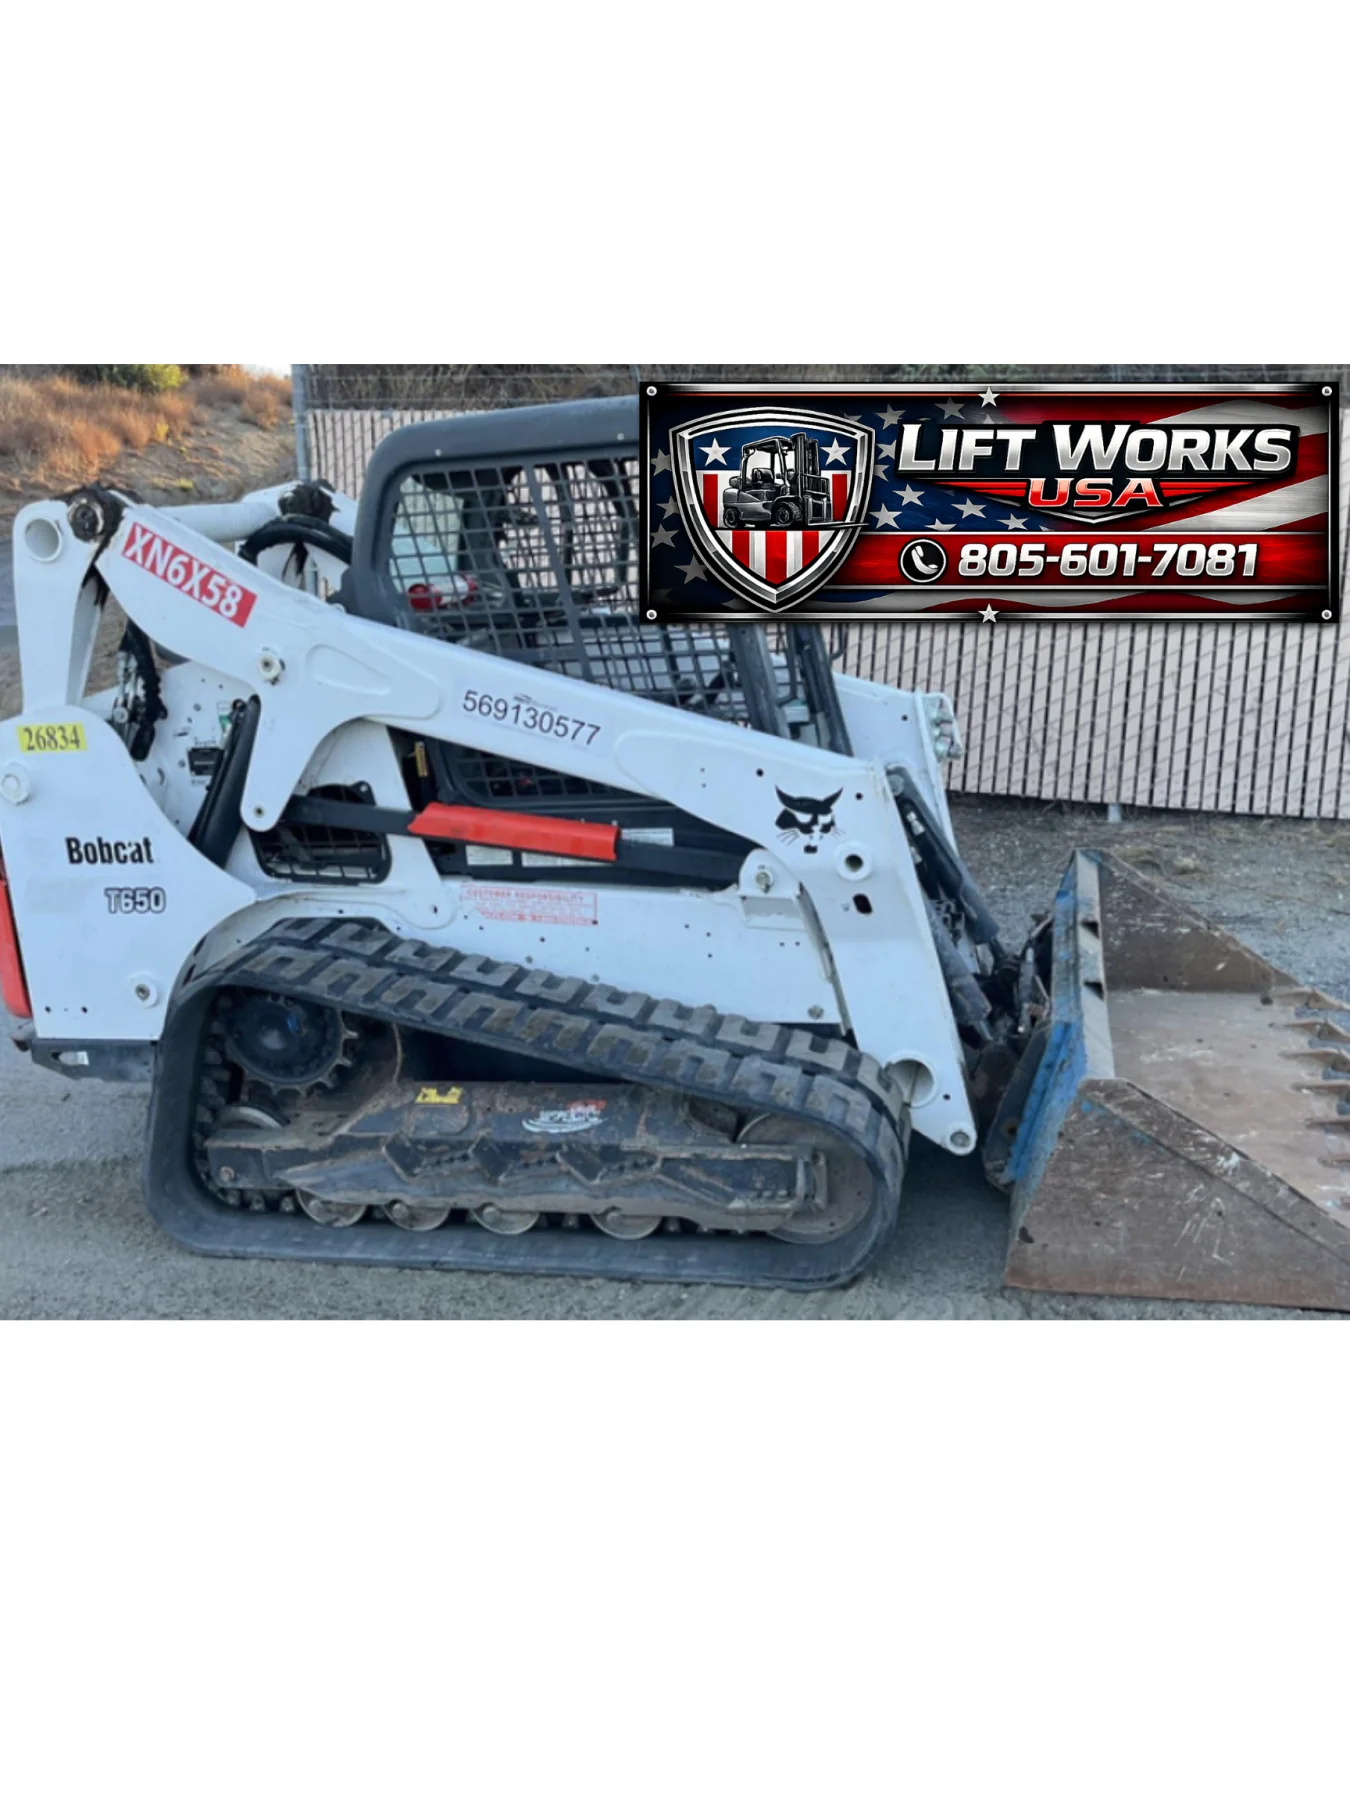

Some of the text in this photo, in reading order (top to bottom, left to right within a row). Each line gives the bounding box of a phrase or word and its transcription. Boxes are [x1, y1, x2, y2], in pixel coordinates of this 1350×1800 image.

[125, 525, 243, 618] XN6X58
[462, 690, 601, 745] 569130577
[25, 726, 81, 751] 26834
[66, 836, 154, 864] Bobcat
[104, 888, 166, 914] T650
